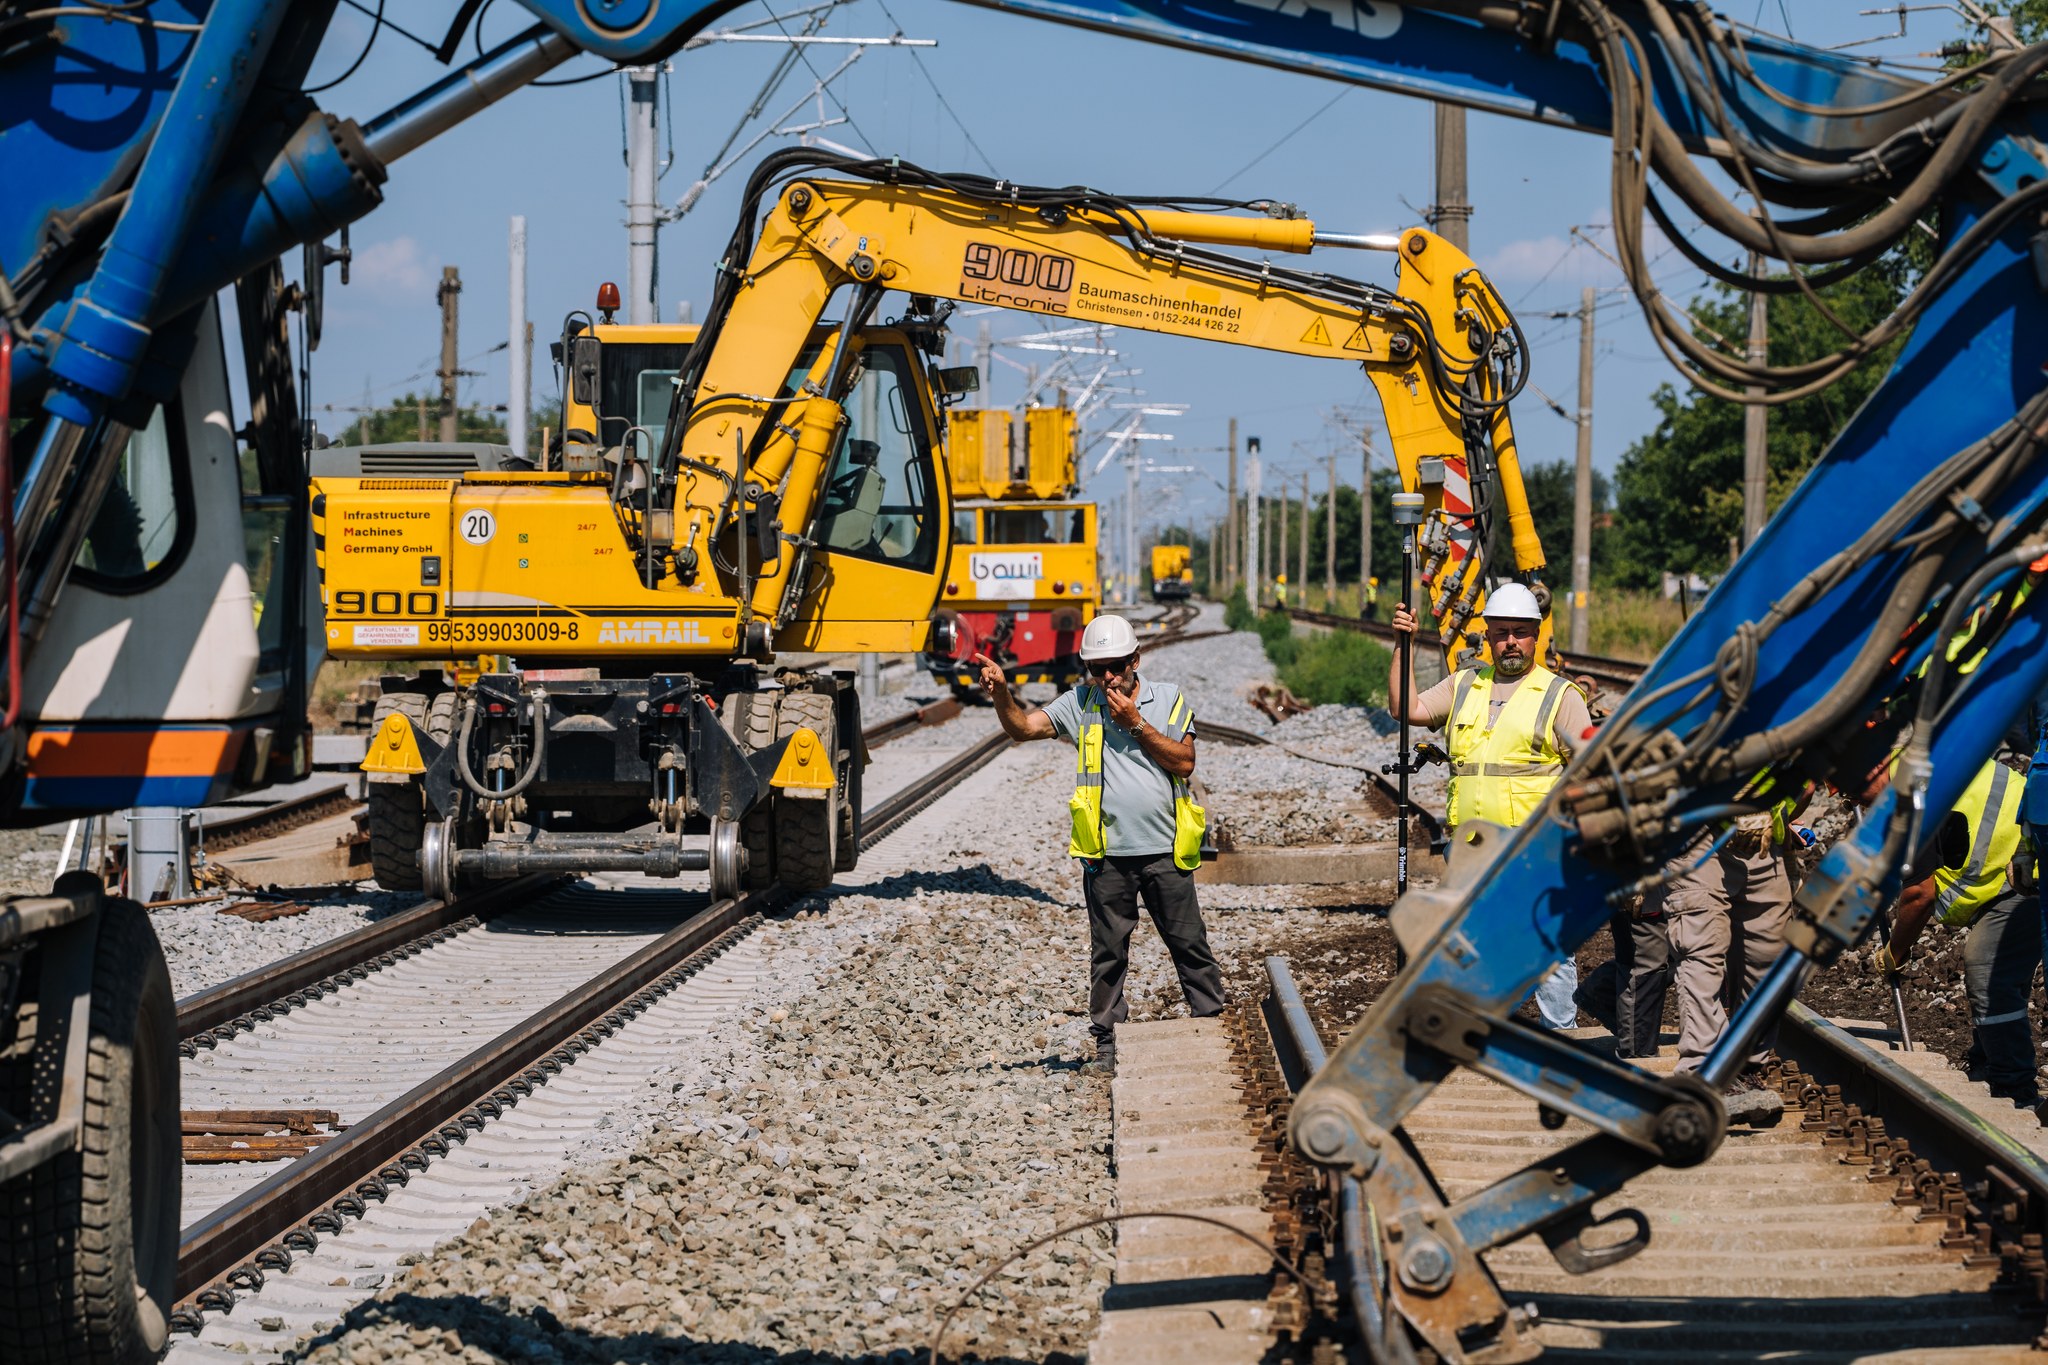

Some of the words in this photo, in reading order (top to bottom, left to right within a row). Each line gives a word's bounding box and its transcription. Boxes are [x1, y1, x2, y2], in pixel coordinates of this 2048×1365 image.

[963, 242, 1075, 292] 900
[959, 282, 1067, 313] Litronic
[1079, 282, 1241, 319] Baumaschinenhandel
[1076, 299, 1143, 318] Christensen
[1153, 311, 1201, 327] 0152-244
[1226, 322, 1240, 333] 22
[343, 511, 431, 520] Infrastructure
[467, 516, 489, 538] 20
[343, 527, 403, 537] Machines
[343, 544, 399, 555] Germany
[402, 545, 433, 553] GmbH
[335, 591, 438, 615] 900
[428, 622, 579, 642] 99539903009-8
[598, 621, 711, 644] AMRAIL
